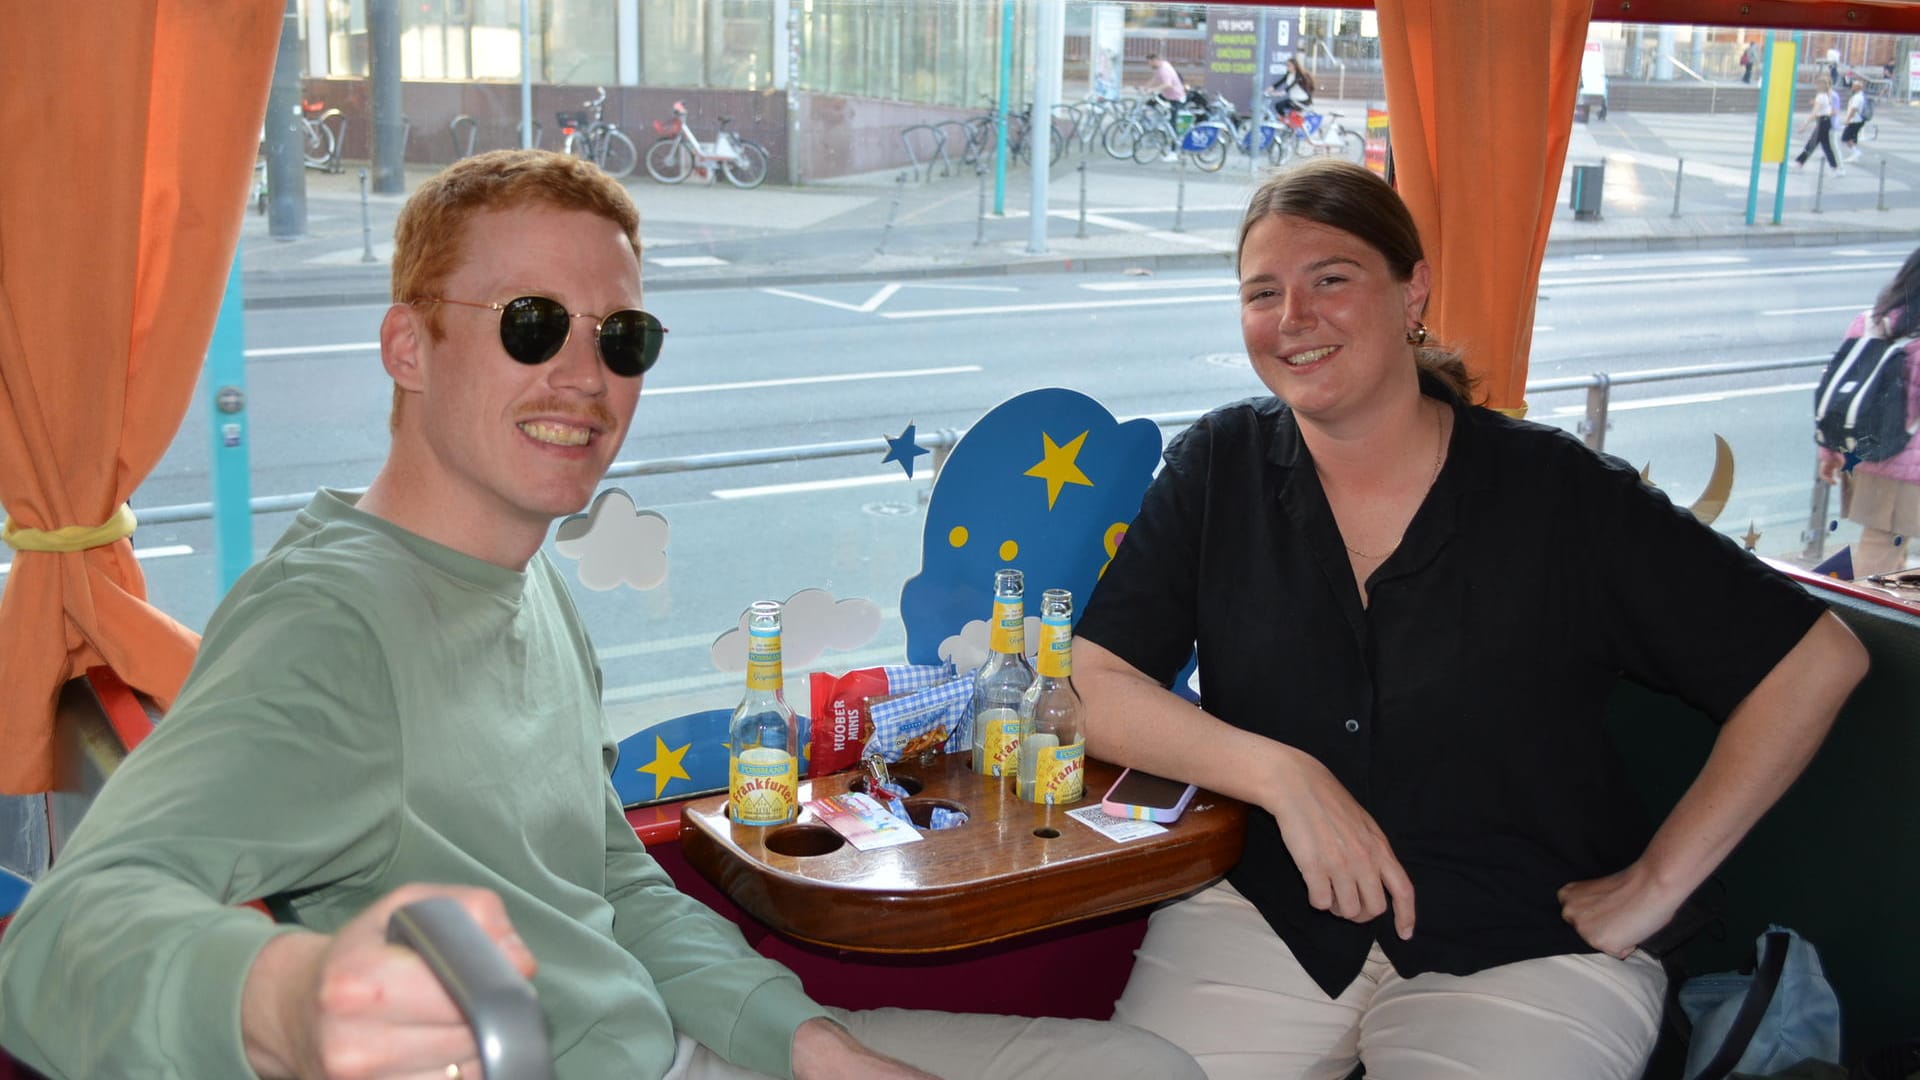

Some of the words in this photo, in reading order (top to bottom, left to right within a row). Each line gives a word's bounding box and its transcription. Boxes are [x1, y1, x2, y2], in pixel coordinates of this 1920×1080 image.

[834, 700, 846, 751] HUOBER
[847, 709, 859, 740] MINIS
[993, 739, 1019, 762] Fran
[732, 777, 793, 804] Frankfurter
